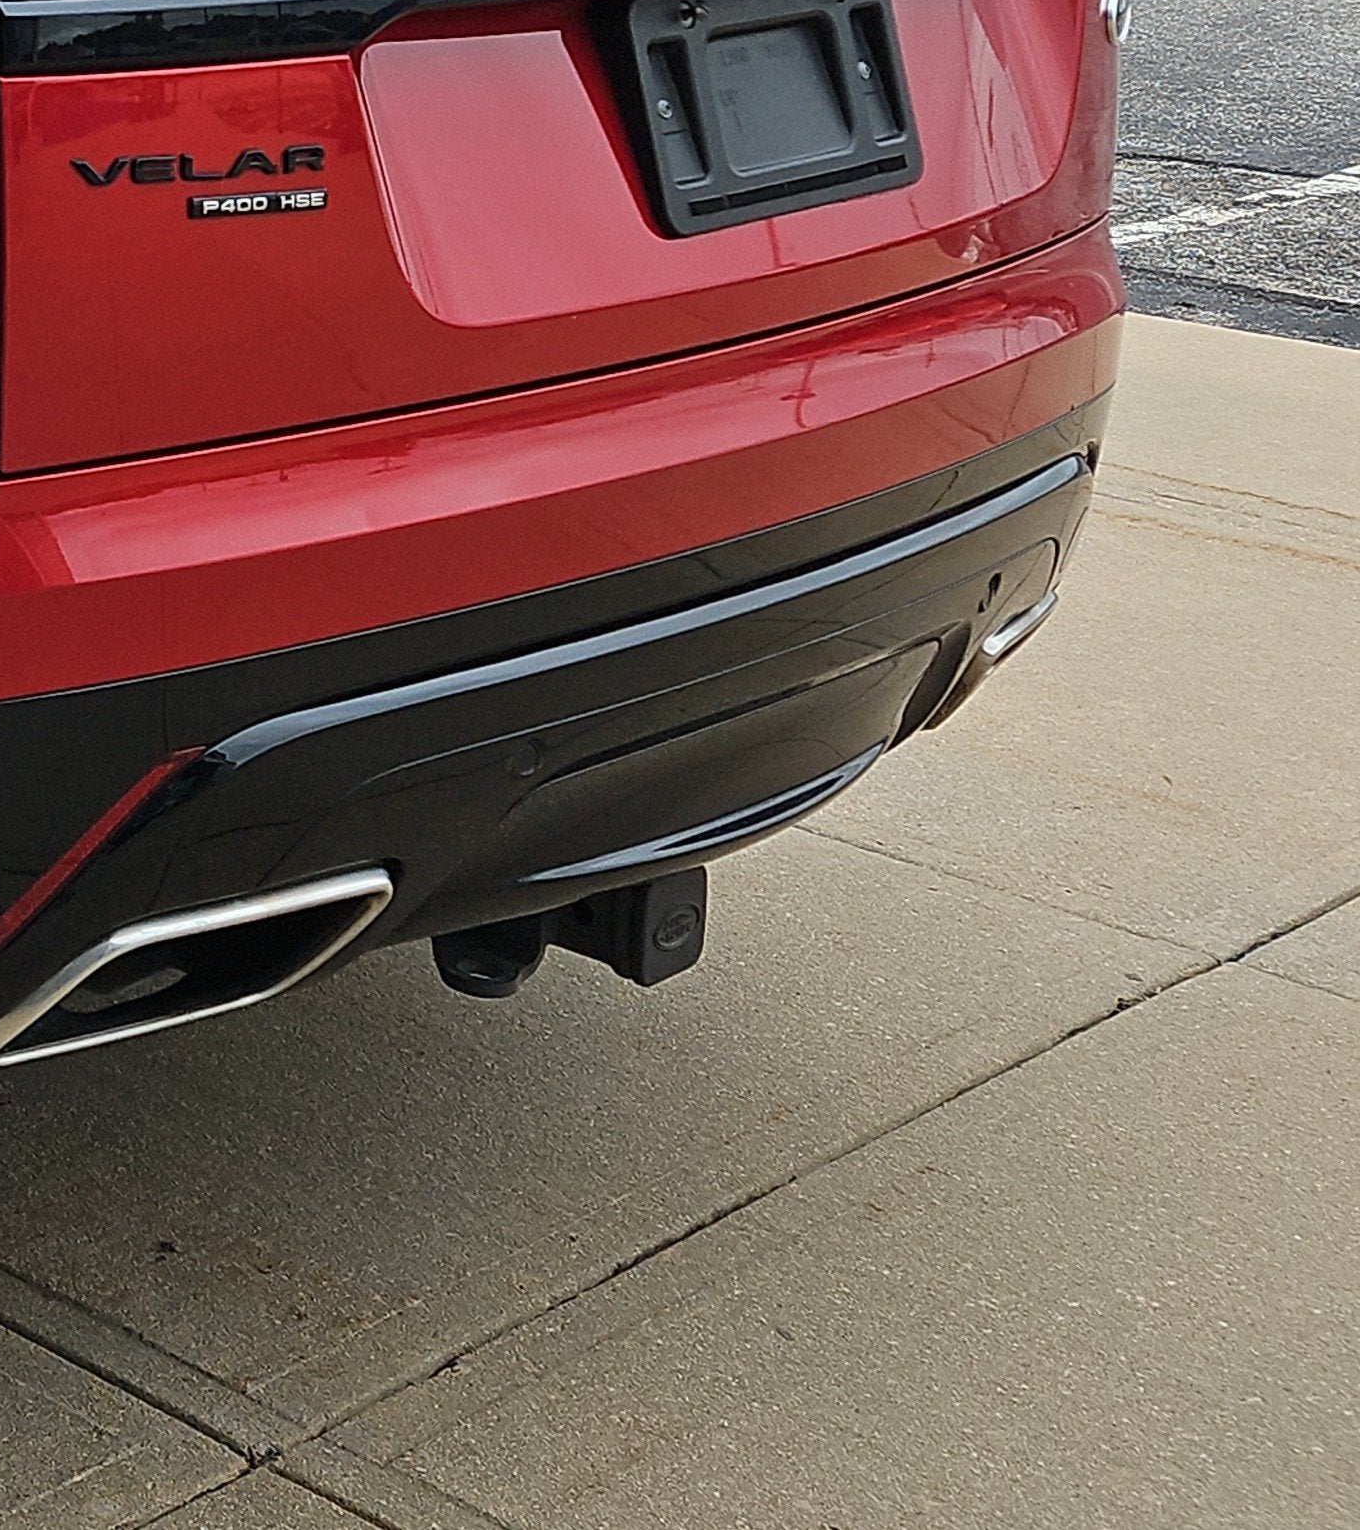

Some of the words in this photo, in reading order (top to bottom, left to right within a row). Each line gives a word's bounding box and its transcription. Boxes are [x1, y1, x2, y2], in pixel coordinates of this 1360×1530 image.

[69, 143, 326, 187] VELAR
[202, 196, 269, 216] P400
[280, 191, 326, 210] HSE
